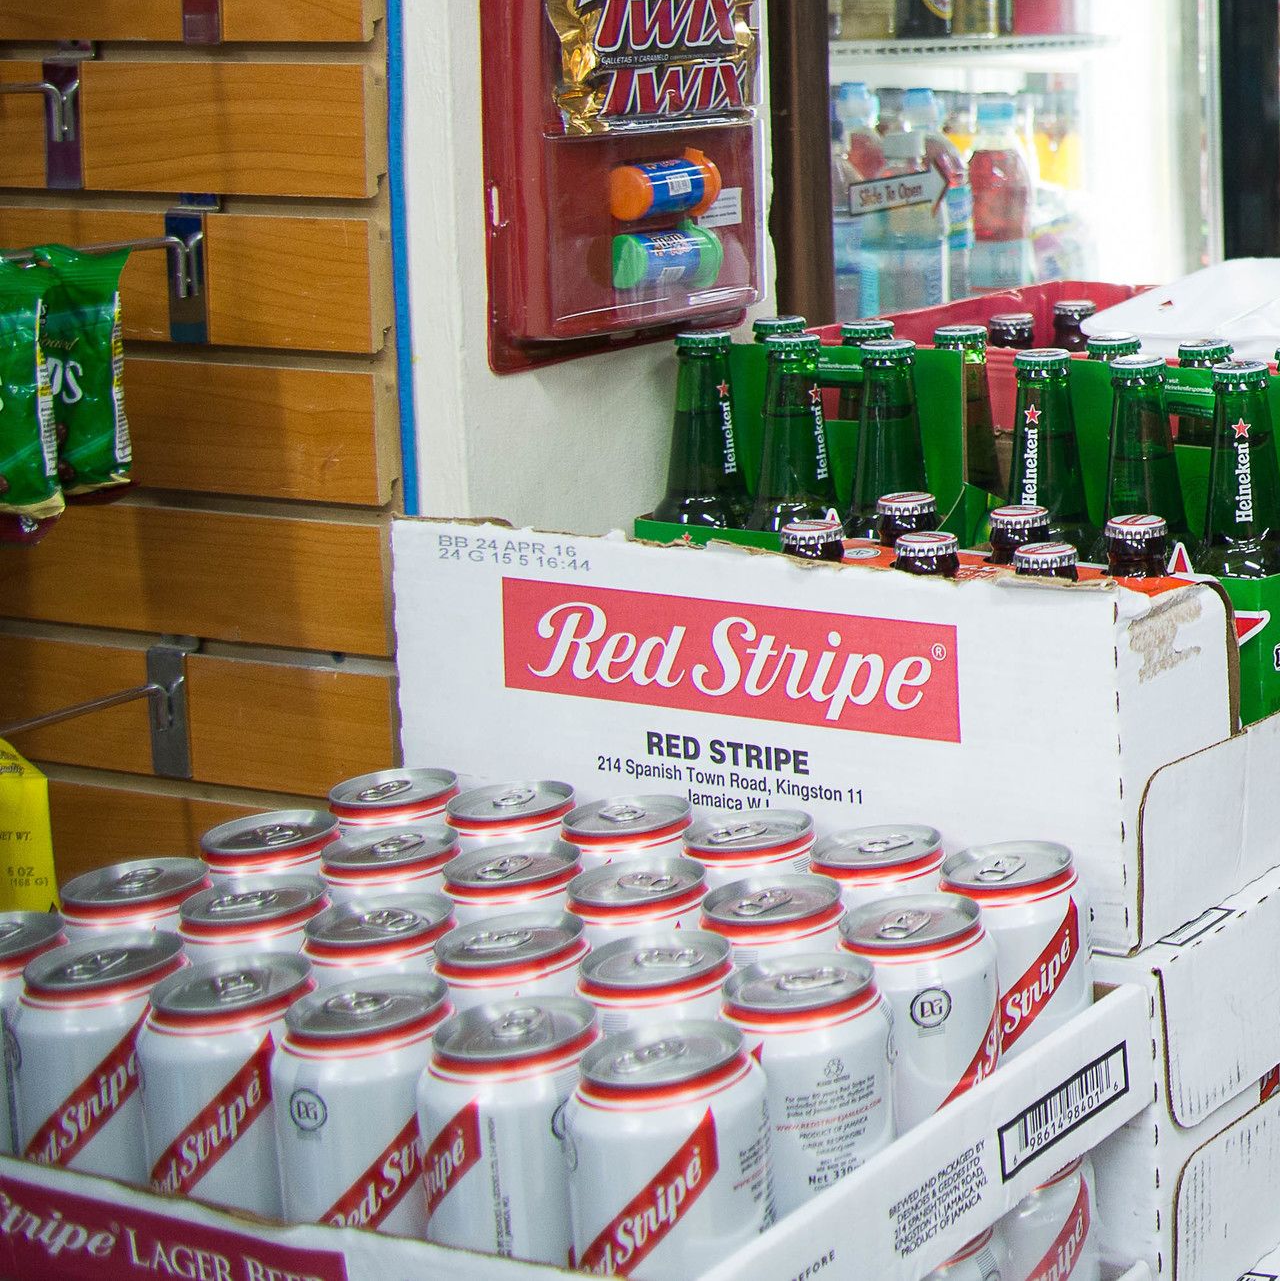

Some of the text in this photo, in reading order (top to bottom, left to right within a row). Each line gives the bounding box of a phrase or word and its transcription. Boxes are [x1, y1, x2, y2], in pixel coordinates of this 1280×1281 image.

[601, 55, 634, 66] GALLETAS
[634, 55, 639, 63] Y
[640, 53, 669, 63] CARAMELO
[858, 181, 923, 207] Slide To Open
[719, 400, 737, 475] Heineken
[810, 405, 829, 480] Heineken
[1021, 427, 1039, 505] Heineken
[1235, 441, 1254, 523] Heineken
[438, 534, 577, 558] BB 24 APR 16
[439, 548, 592, 572] 24 G 15 5 16:44
[528, 601, 933, 722] Red Stripe
[646, 730, 810, 776] RED STRIPE
[598, 755, 863, 804] 214 Spanish Town Road, Kingston 11
[1002, 926, 1075, 1036] Stripe
[1113, 1081, 1120, 1092] 6
[179, 1068, 262, 1174] Stripe
[921, 1177, 936, 1195] AND
[938, 1148, 974, 1179] PACKAGED
[1013, 1156, 1020, 1167] 6
[612, 1146, 708, 1253] Stripe
[940, 1214, 951, 1230] OF
[951, 1193, 982, 1225] JAMAICA
[126, 1224, 234, 1281] LAGER
[792, 1249, 836, 1281] EFORE
